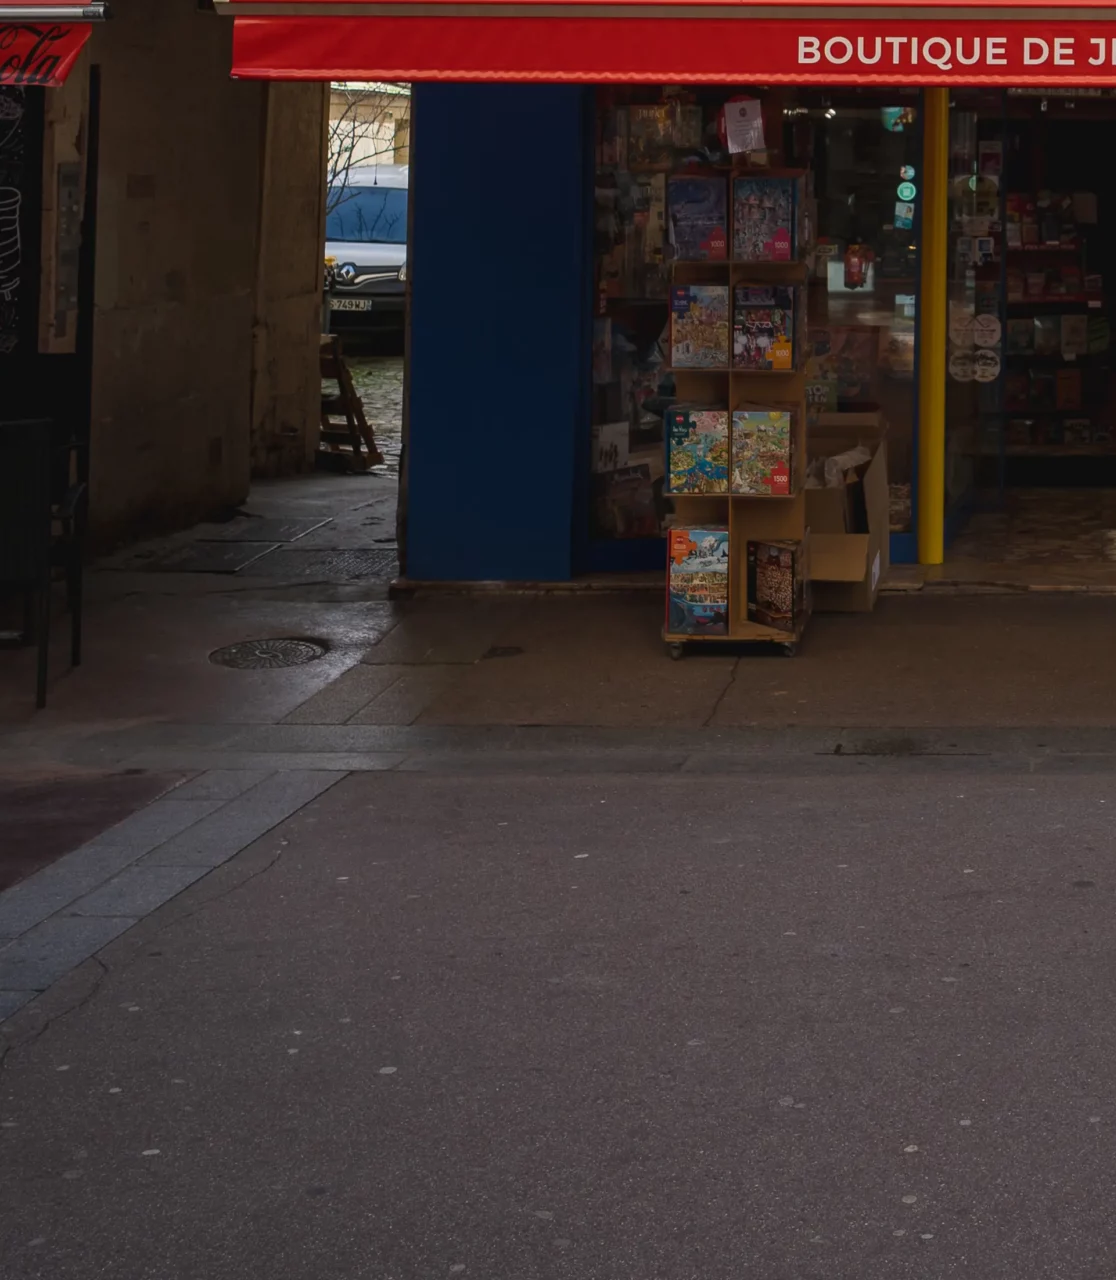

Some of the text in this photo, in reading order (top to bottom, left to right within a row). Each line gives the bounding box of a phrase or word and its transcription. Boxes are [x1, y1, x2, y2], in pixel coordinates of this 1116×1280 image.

[797, 36, 1008, 70] BOUTIQUE
[1023, 37, 1075, 66] DE
[774, 240, 789, 249] 1000
[773, 474, 788, 483] 1500
